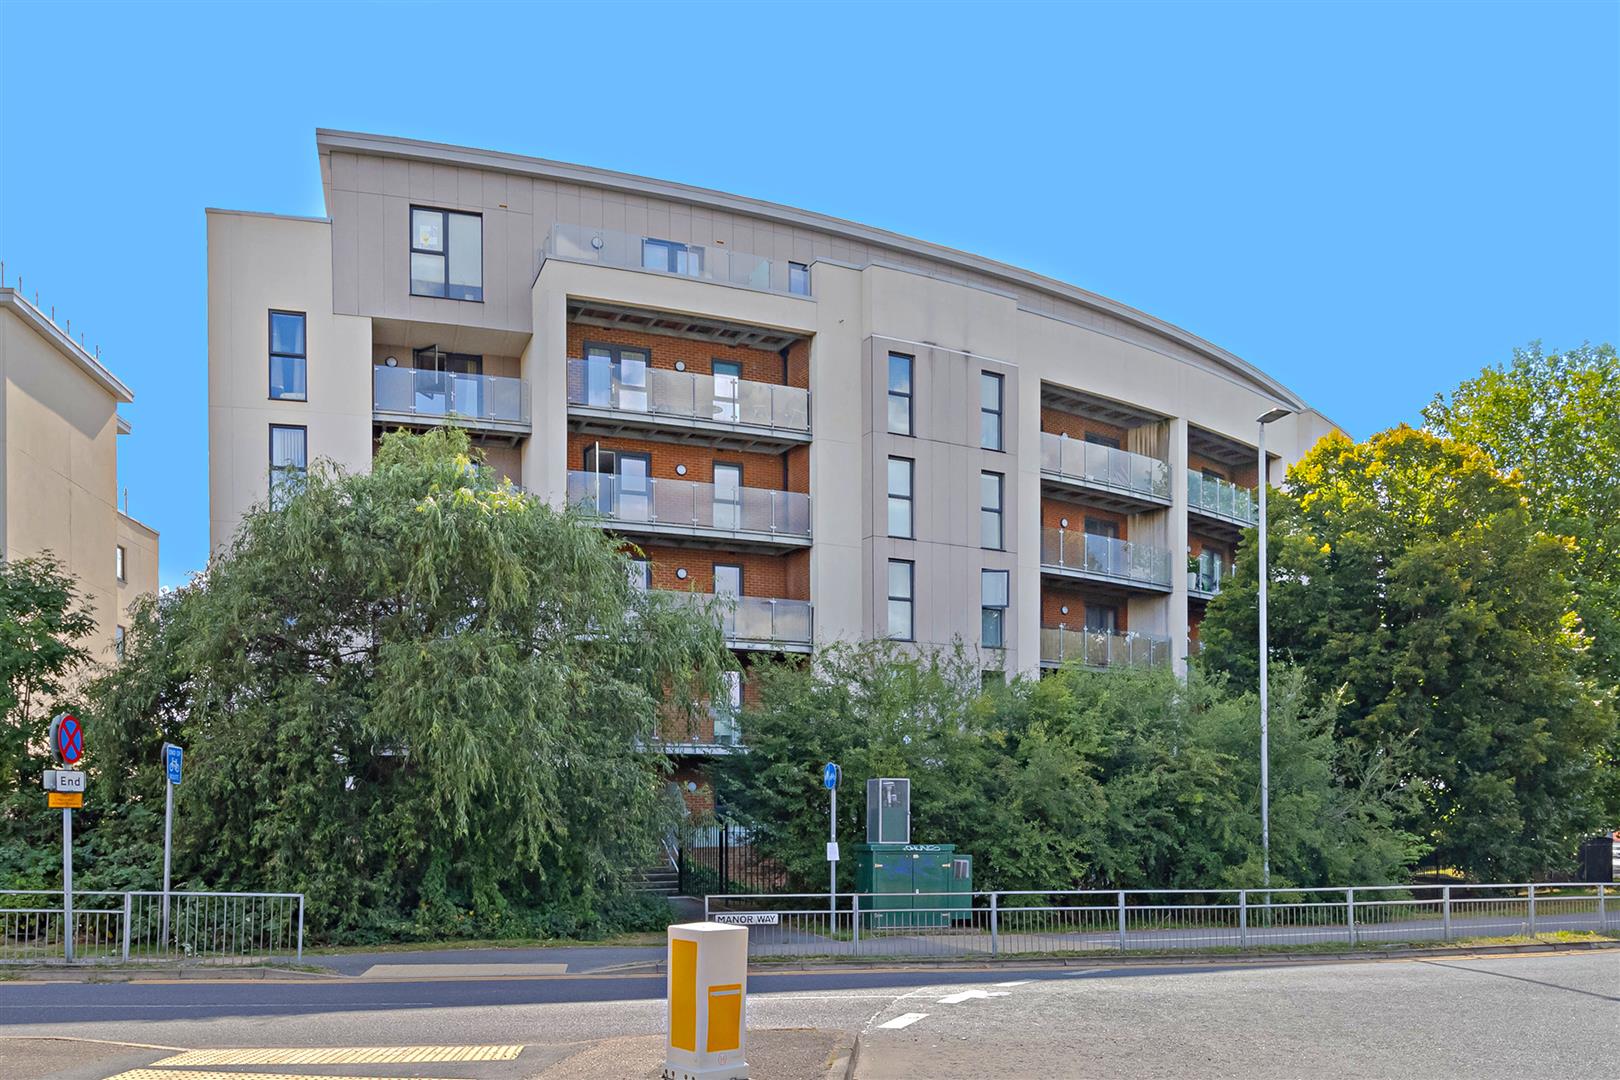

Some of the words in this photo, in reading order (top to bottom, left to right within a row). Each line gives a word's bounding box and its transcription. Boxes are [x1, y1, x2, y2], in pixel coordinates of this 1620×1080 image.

[60, 776, 81, 787] End
[717, 915, 753, 924] MANOR
[756, 915, 776, 923] WAY
